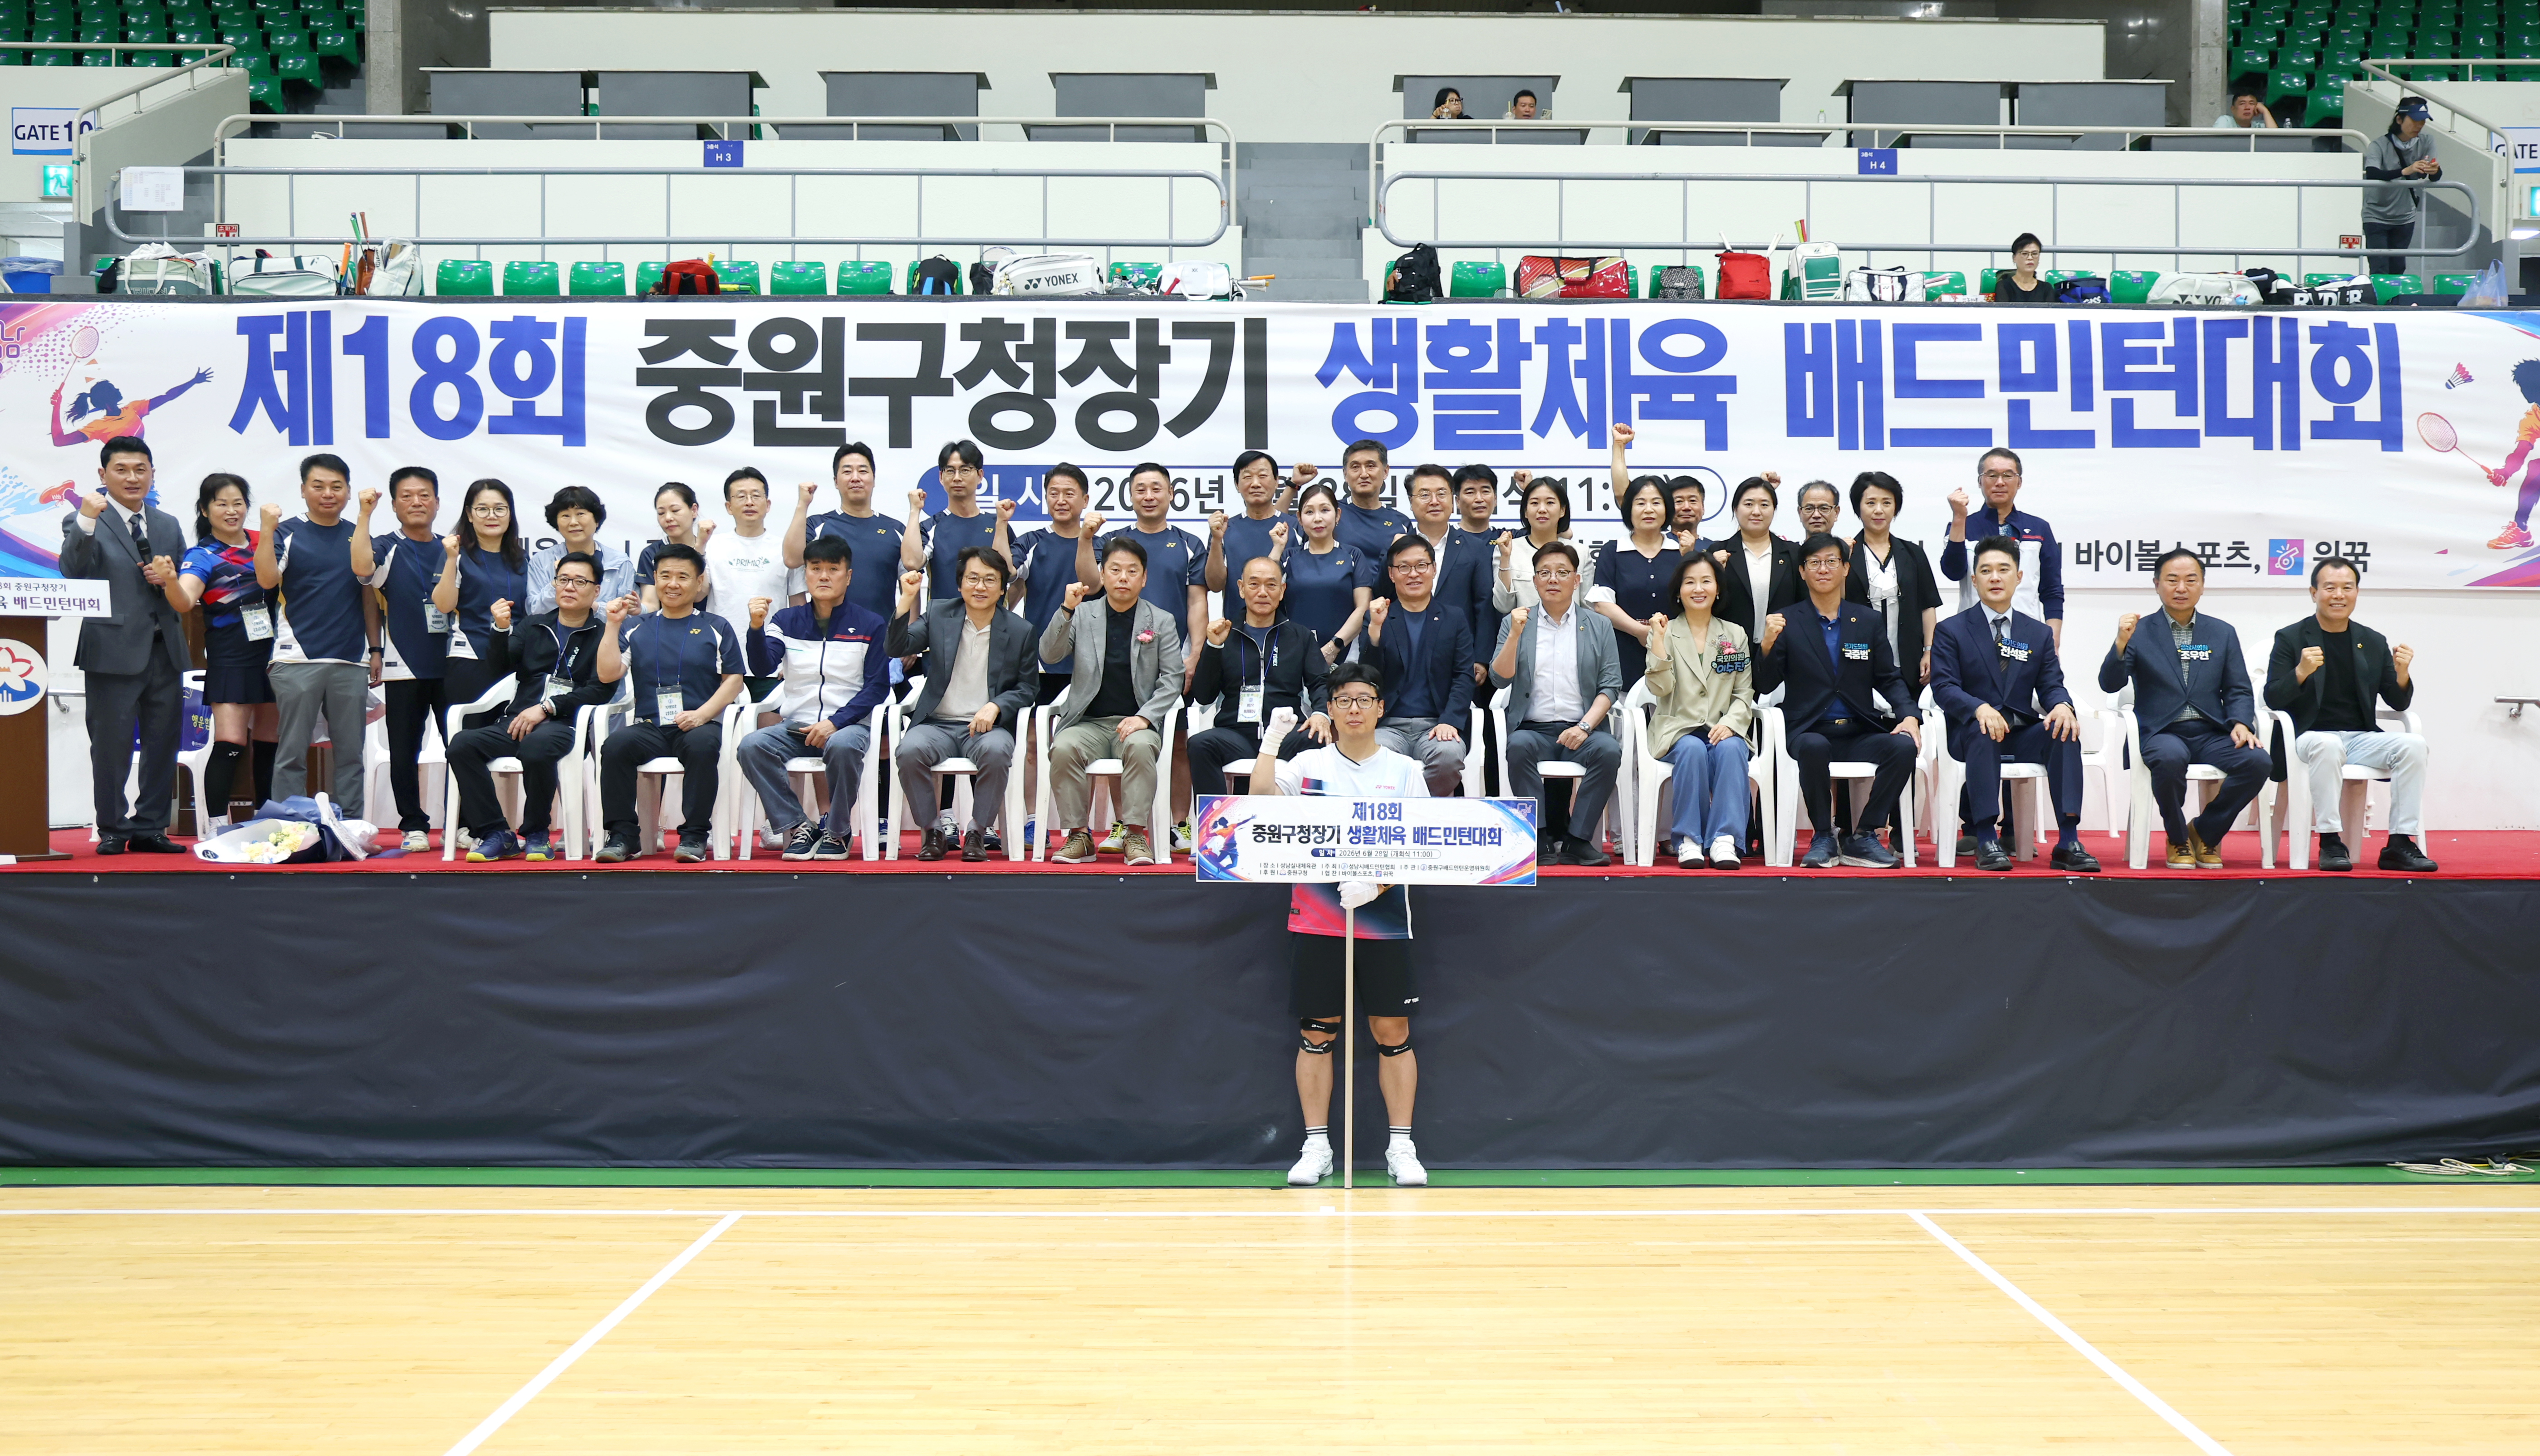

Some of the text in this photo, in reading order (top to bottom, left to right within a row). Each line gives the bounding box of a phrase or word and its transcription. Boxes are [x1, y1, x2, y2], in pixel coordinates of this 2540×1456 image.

[15, 124, 59, 140] GATE
[716, 153, 731, 162] H 3
[1870, 161, 1886, 169] H 4
[1044, 273, 1079, 287] YONEX
[228, 310, 2404, 452] 제18회 중원구청장기 생활체육 배드민턴대회
[15, 582, 66, 592] 중원구청장기
[13, 596, 100, 611] 배드민턴대회
[2001, 637, 2029, 650] 경기도의원
[1716, 653, 1746, 663] 국회의원
[1844, 649, 1869, 660] 국중범
[2001, 645, 2028, 662] 전석훈
[2180, 650, 2209, 660] 조우현
[567, 654, 576, 668] YONEX
[1716, 661, 1745, 674] 이수진
[1352, 802, 1402, 822] 제18회
[1252, 824, 1502, 847] 중원구청장기 생활체육 배드민턴대회
